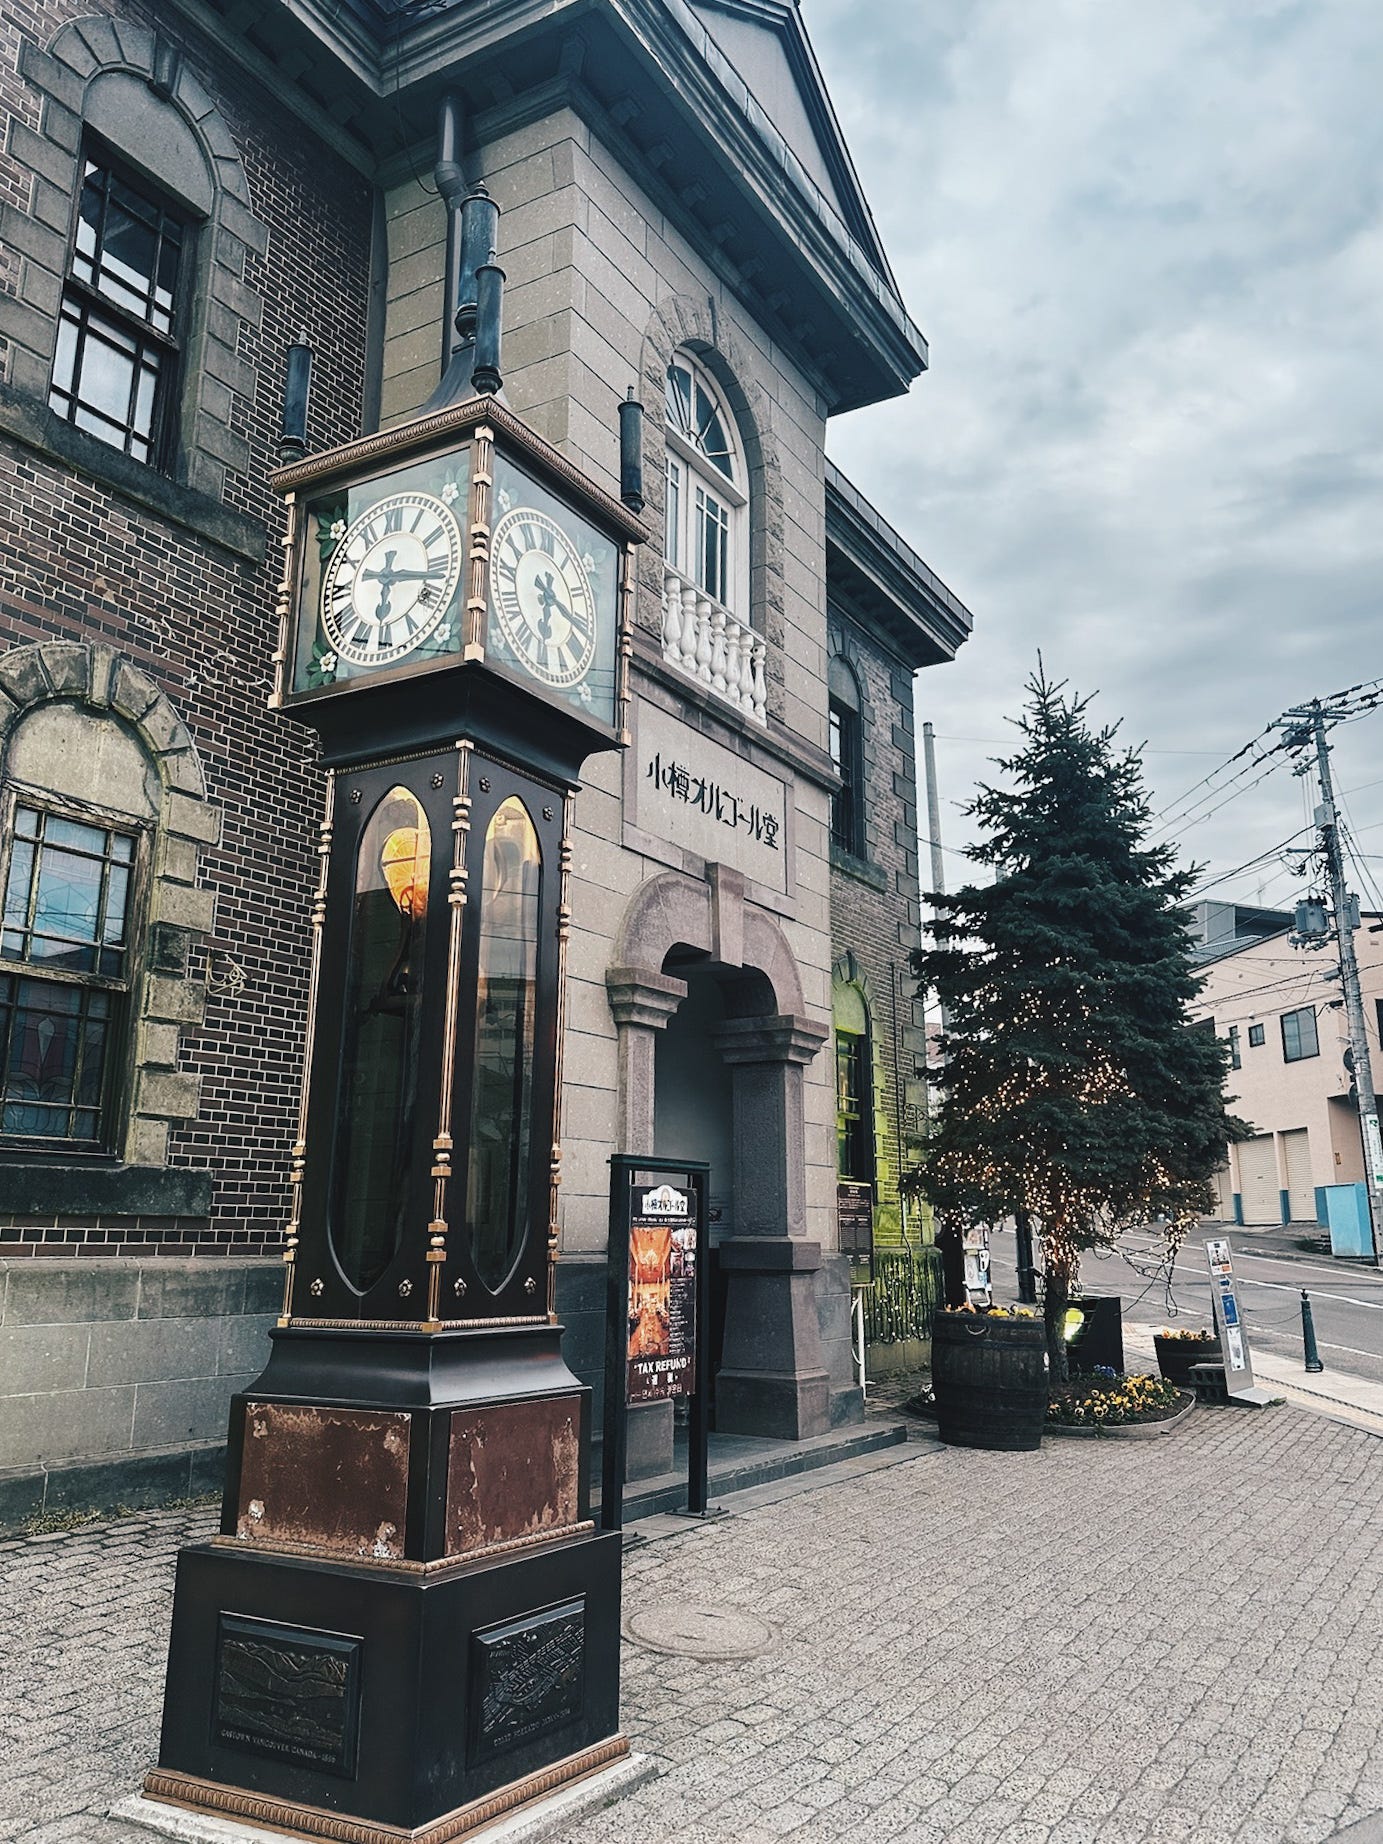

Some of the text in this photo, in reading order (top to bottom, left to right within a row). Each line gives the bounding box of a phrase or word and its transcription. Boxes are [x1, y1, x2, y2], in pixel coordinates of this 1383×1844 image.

[384, 507, 404, 536] XII
[422, 525, 445, 549] II
[646, 752, 779, 851] 小樽オルゴール堂
